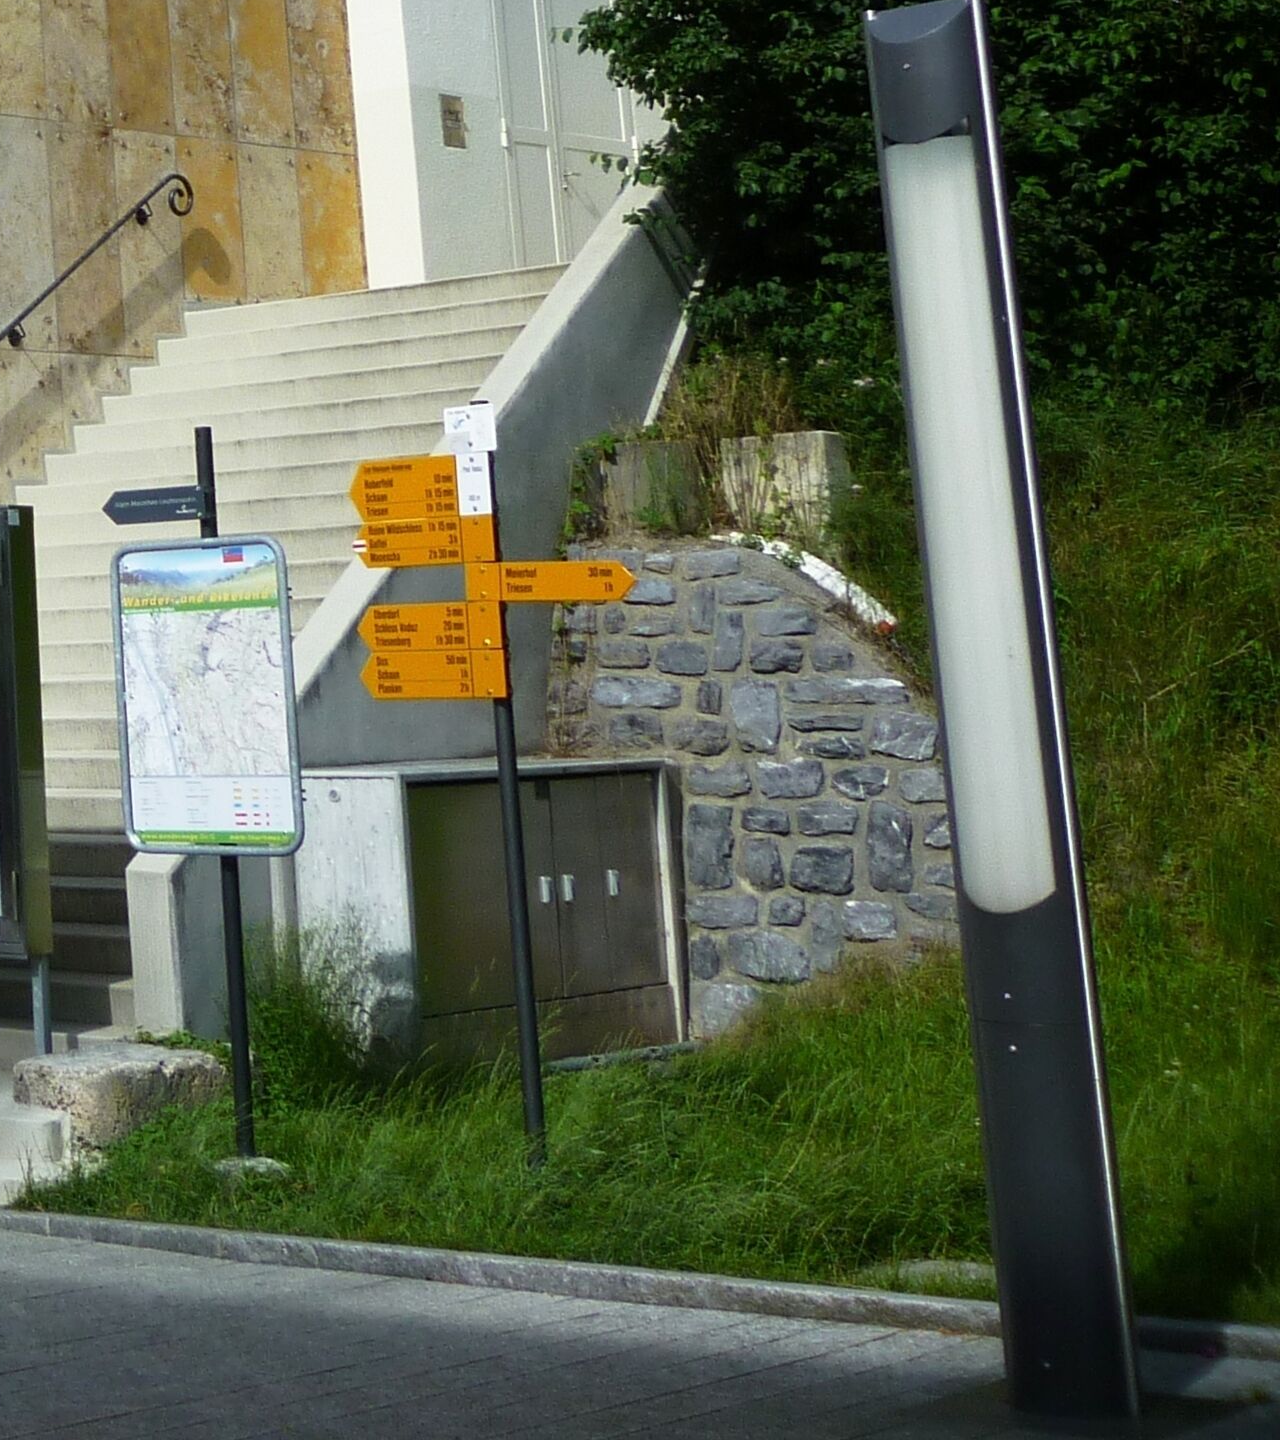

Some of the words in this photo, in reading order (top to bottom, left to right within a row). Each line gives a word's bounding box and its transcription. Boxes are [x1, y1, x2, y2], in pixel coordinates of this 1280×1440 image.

[442, 475, 453, 483] min
[365, 493, 388, 503] Schaan
[434, 488, 442, 497] 15
[442, 489, 454, 497] min
[366, 507, 389, 516] Triesen
[435, 502, 443, 512] 15
[443, 503, 455, 511] min
[438, 521, 445, 531] 15
[446, 522, 457, 530] min
[438, 549, 447, 559] 30
[505, 567, 537, 578] Meierhof
[588, 567, 598, 577] 30
[599, 567, 612, 577] min
[506, 583, 533, 593] Triesen
[180, 593, 204, 604] und
[374, 609, 399, 619] Oberdorf
[452, 608, 463, 616] min
[375, 623, 398, 633] Schloss
[400, 622, 418, 632] Vaduz
[443, 620, 452, 631] 20
[453, 622, 464, 630] min
[375, 637, 411, 647] Triesenberg
[444, 634, 453, 645] 30
[454, 636, 465, 644] min
[446, 655, 455, 665] 50
[456, 656, 467, 664] min
[378, 670, 399, 679] Schaan
[378, 684, 402, 693] Planken
